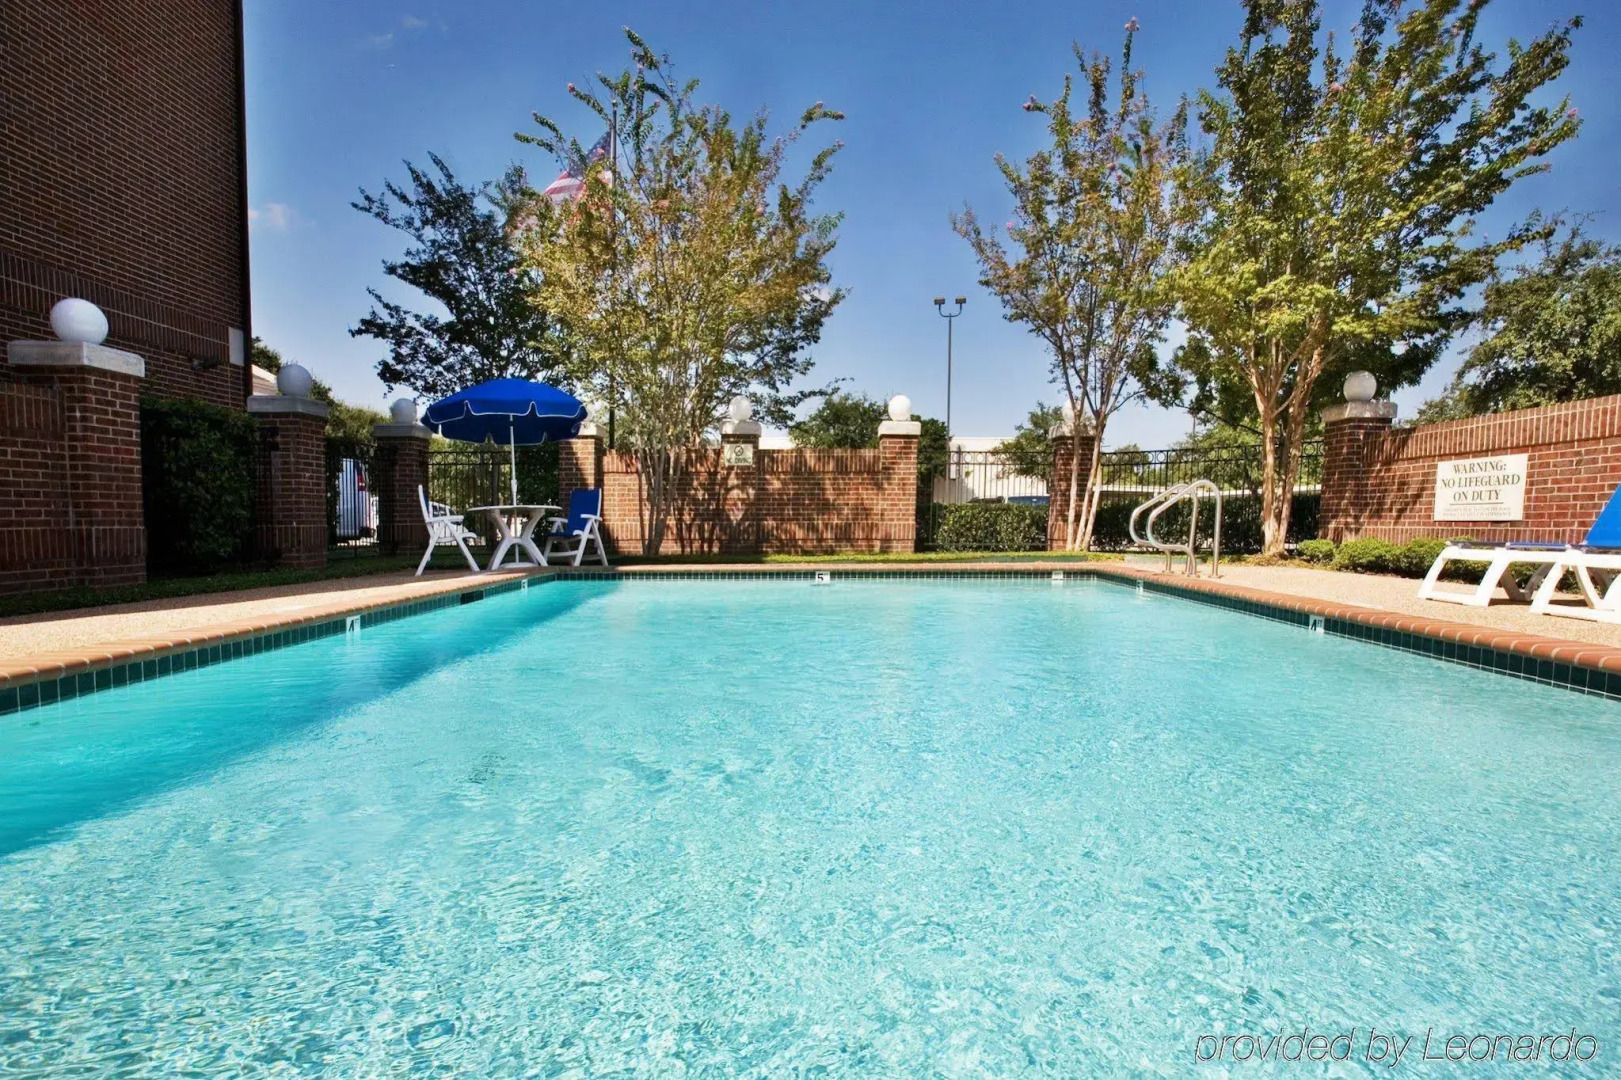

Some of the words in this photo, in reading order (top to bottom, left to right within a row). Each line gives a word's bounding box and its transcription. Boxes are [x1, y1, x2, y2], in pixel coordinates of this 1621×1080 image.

[1453, 460, 1507, 474] WARNING:
[1441, 478, 1456, 489] NO
[1458, 474, 1521, 488] LIFEGUARD
[1453, 490, 1468, 502] ON
[1471, 489, 1502, 502] DUTY
[817, 573, 824, 581] 5
